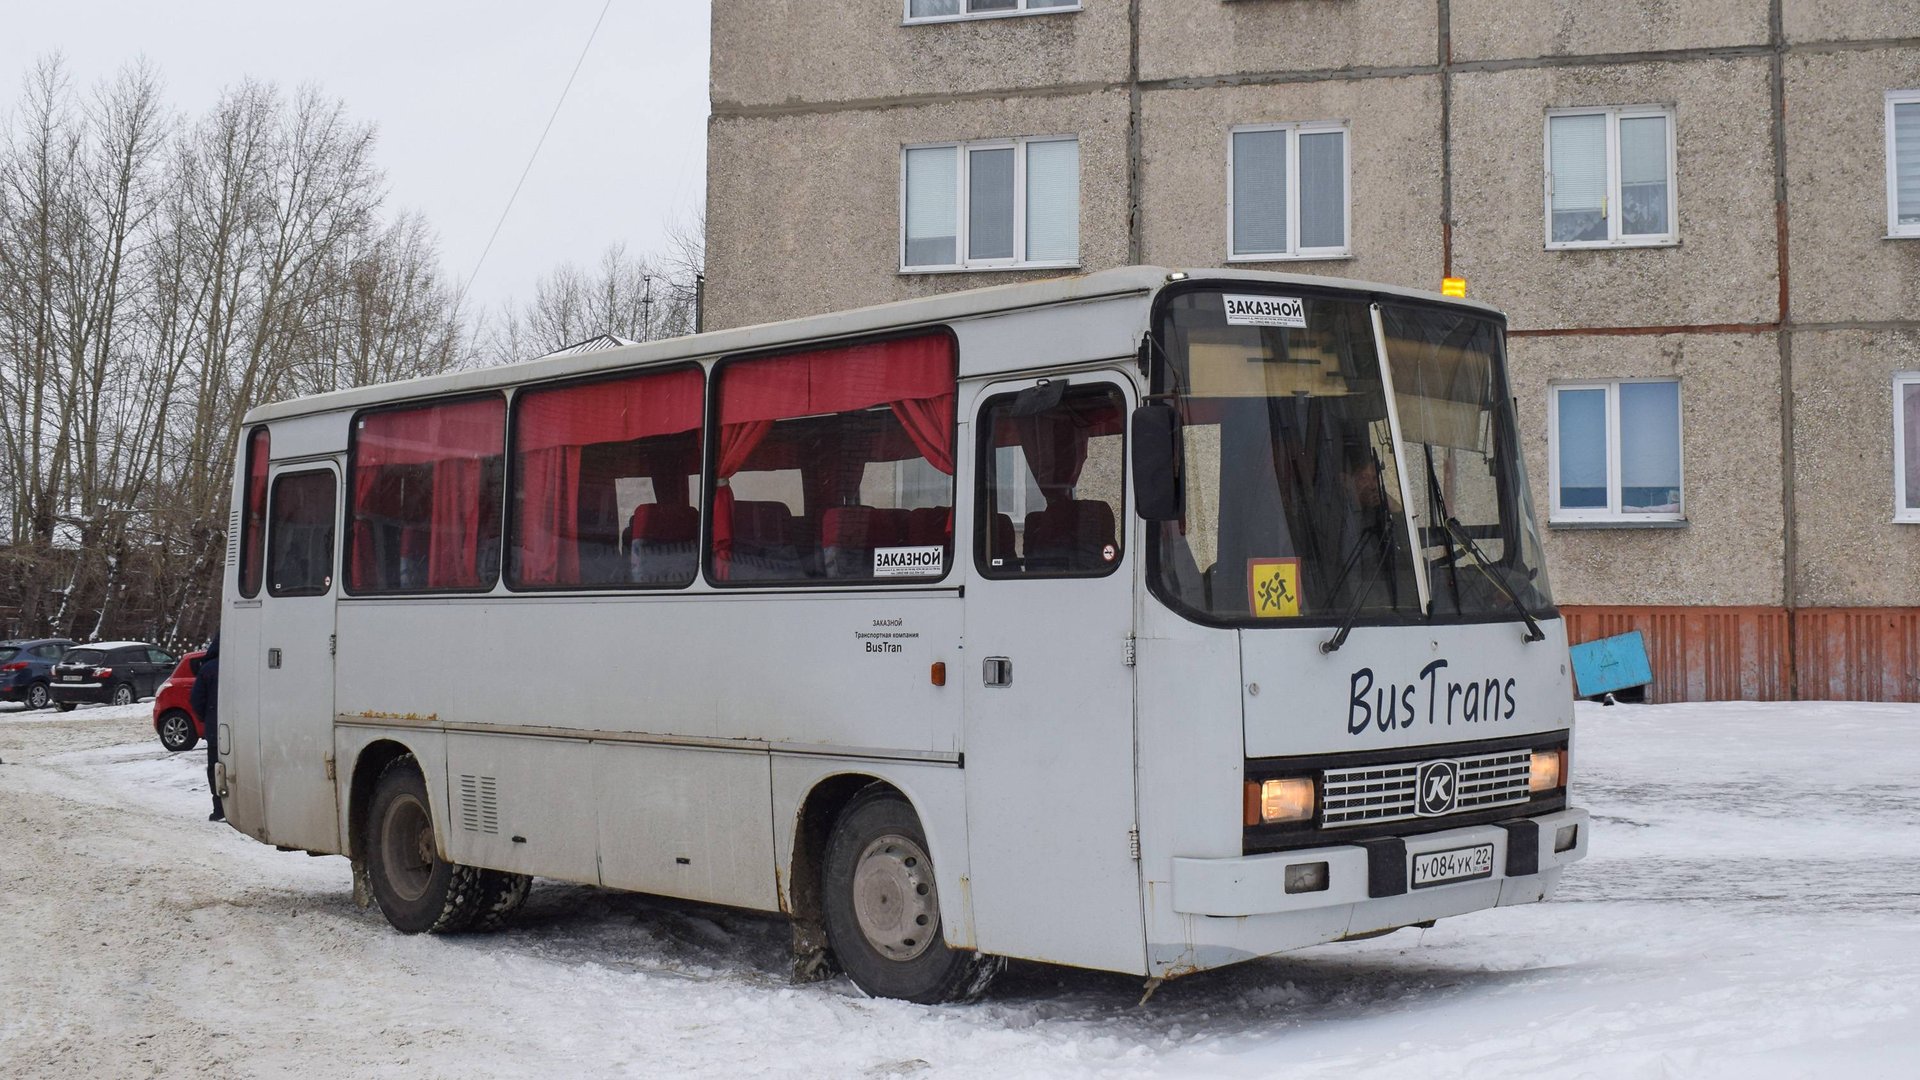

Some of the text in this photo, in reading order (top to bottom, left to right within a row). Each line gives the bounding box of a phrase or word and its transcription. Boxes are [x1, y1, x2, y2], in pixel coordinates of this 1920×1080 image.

[1227, 299, 1302, 318] ЗАКАЗНОЙ
[877, 547, 941, 567] ЗАКАЗНОЙ
[872, 618, 903, 627] ЗАКАЗНОЙ
[855, 631, 892, 639] Транспортная
[866, 641, 902, 653] BusTran
[1347, 658, 1517, 736] BusTrans
